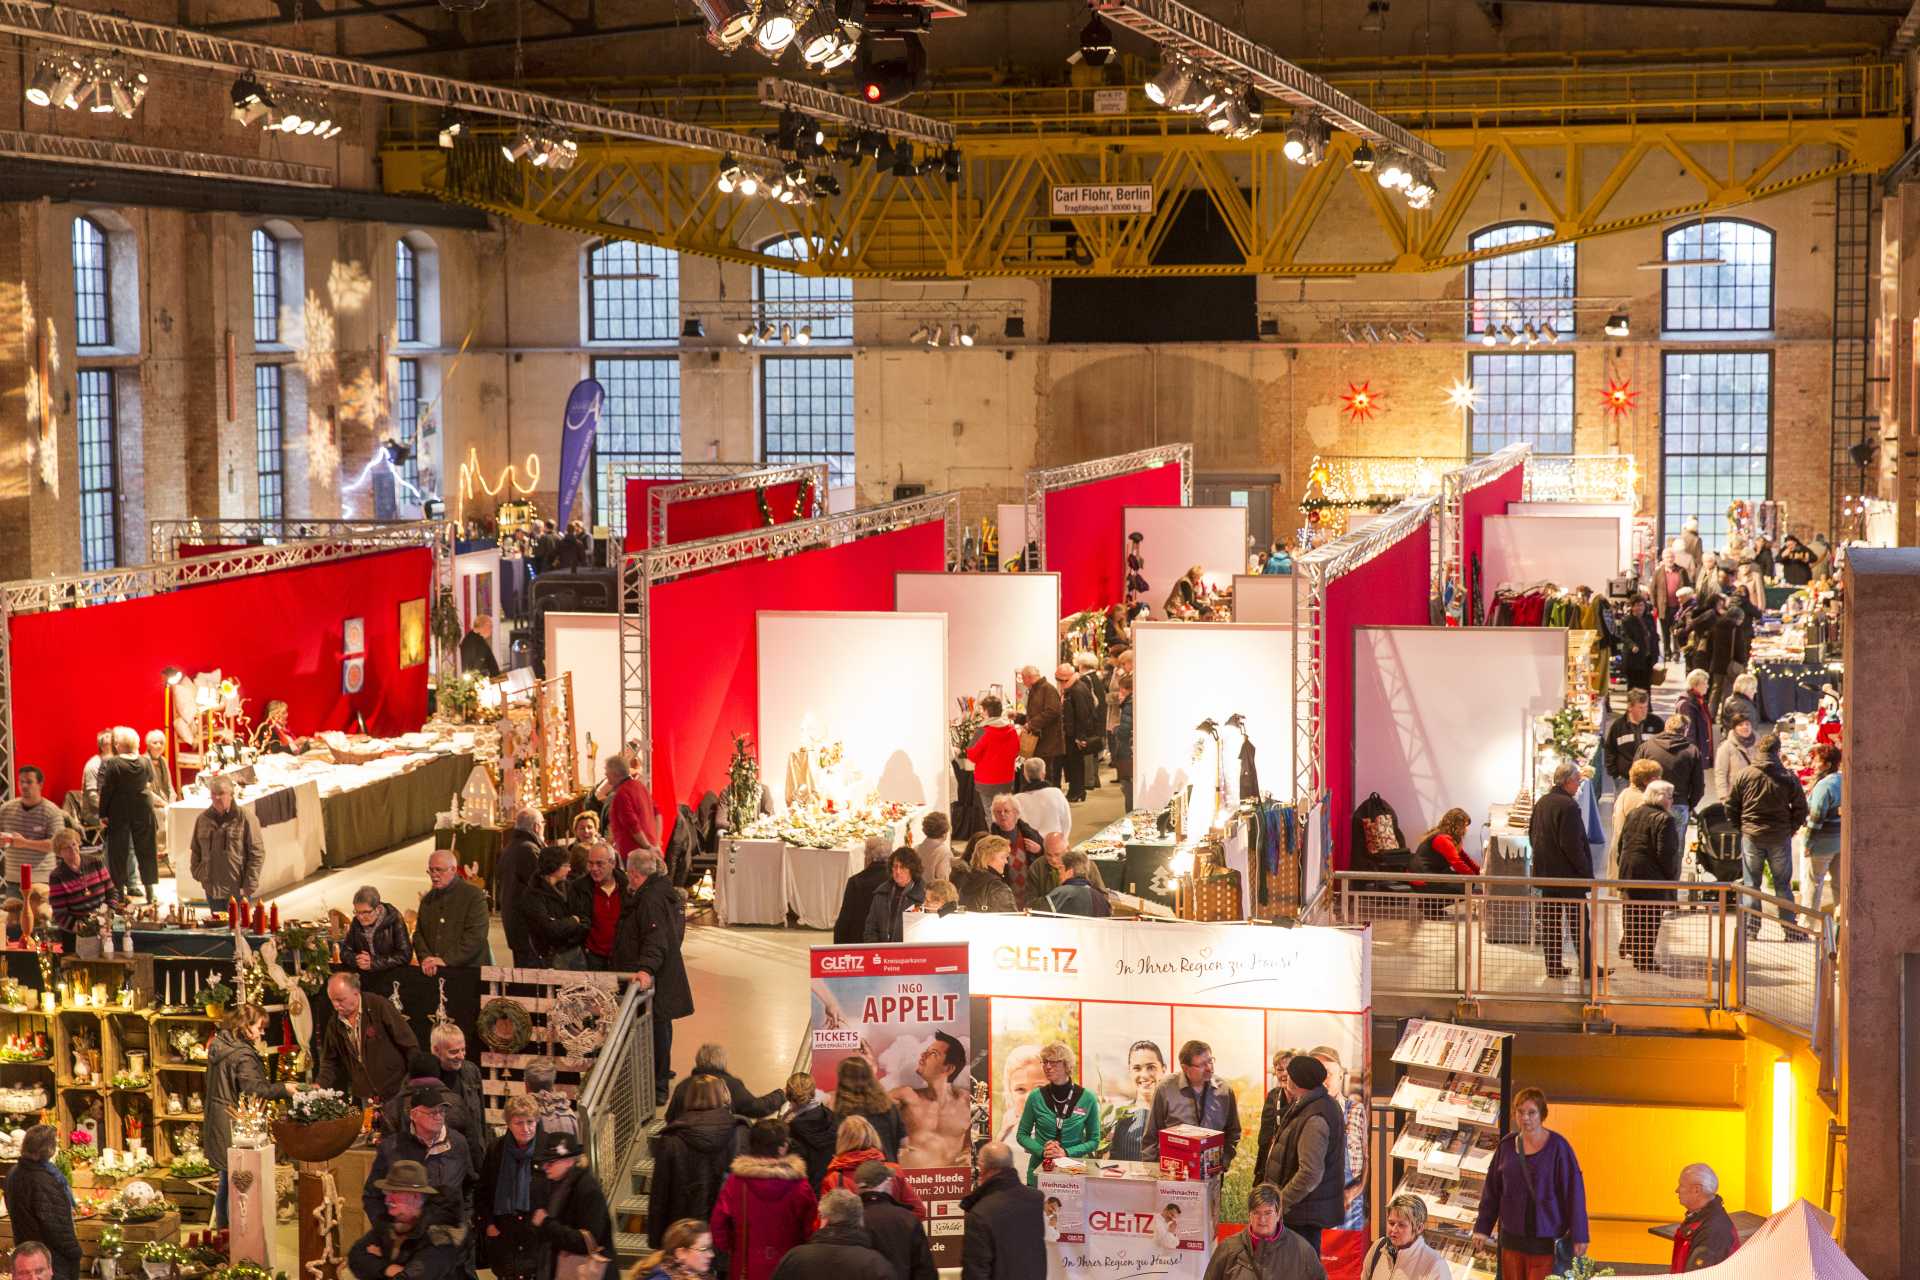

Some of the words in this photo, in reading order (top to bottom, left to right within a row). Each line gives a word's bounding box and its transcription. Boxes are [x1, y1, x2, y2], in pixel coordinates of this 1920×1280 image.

[1055, 188, 1078, 202] Carl
[1081, 188, 1113, 202] Flohr,
[1116, 187, 1150, 201] Berlin
[1115, 959, 1134, 975] In
[1138, 955, 1176, 974] Ihrer
[1180, 957, 1222, 978] Region
[898, 983, 923, 994] INGO
[862, 994, 958, 1023] APPELT
[814, 1031, 858, 1042] TICKETS
[933, 1186, 945, 1195] 20
[947, 1185, 964, 1194] Uhr
[1041, 1181, 1080, 1190] Weihnachts
[1160, 1188, 1199, 1197] Weihnachts
[929, 1242, 945, 1251] .de
[1063, 1256, 1074, 1268] In
[1078, 1254, 1102, 1267] Ihrer
[1104, 1256, 1134, 1270] Region
[1136, 1259, 1148, 1270] zu
[1150, 1253, 1183, 1266] Hause!
